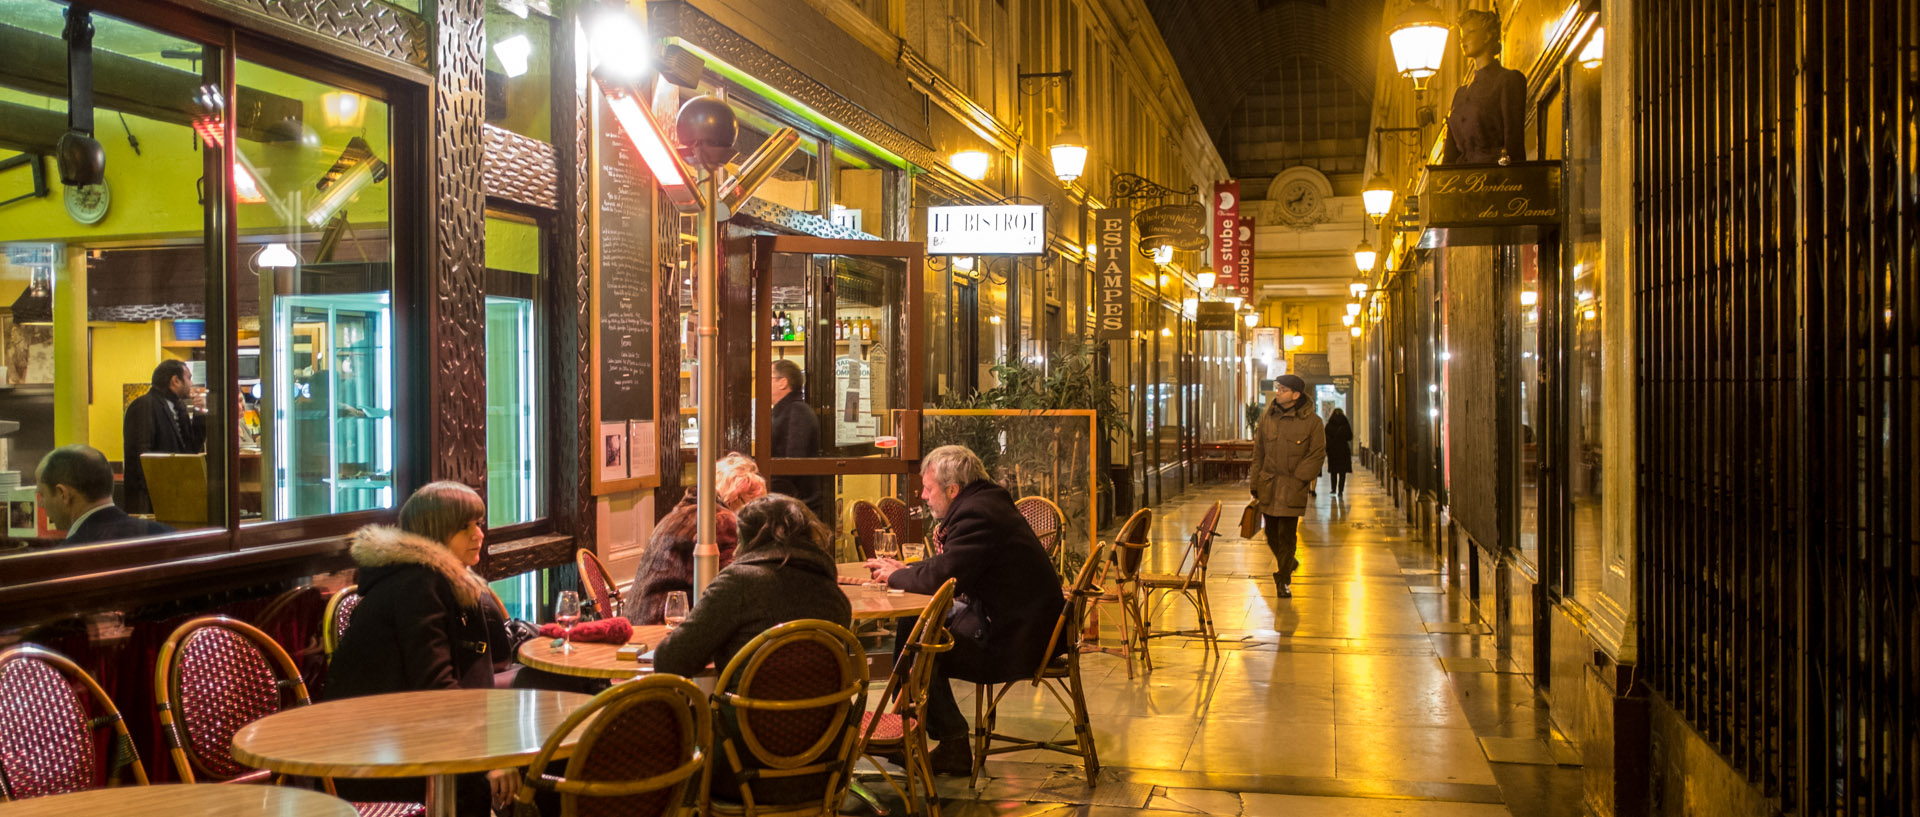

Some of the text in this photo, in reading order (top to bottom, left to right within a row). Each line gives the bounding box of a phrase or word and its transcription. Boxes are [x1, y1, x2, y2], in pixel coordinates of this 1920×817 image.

[1433, 172, 1523, 194] Le Bonheur
[1478, 197, 1556, 218] des Dames
[1219, 219, 1234, 261] stube
[1103, 218, 1123, 330] ESTAMPES
[1219, 265, 1233, 278] le
[1238, 249, 1250, 284] stube
